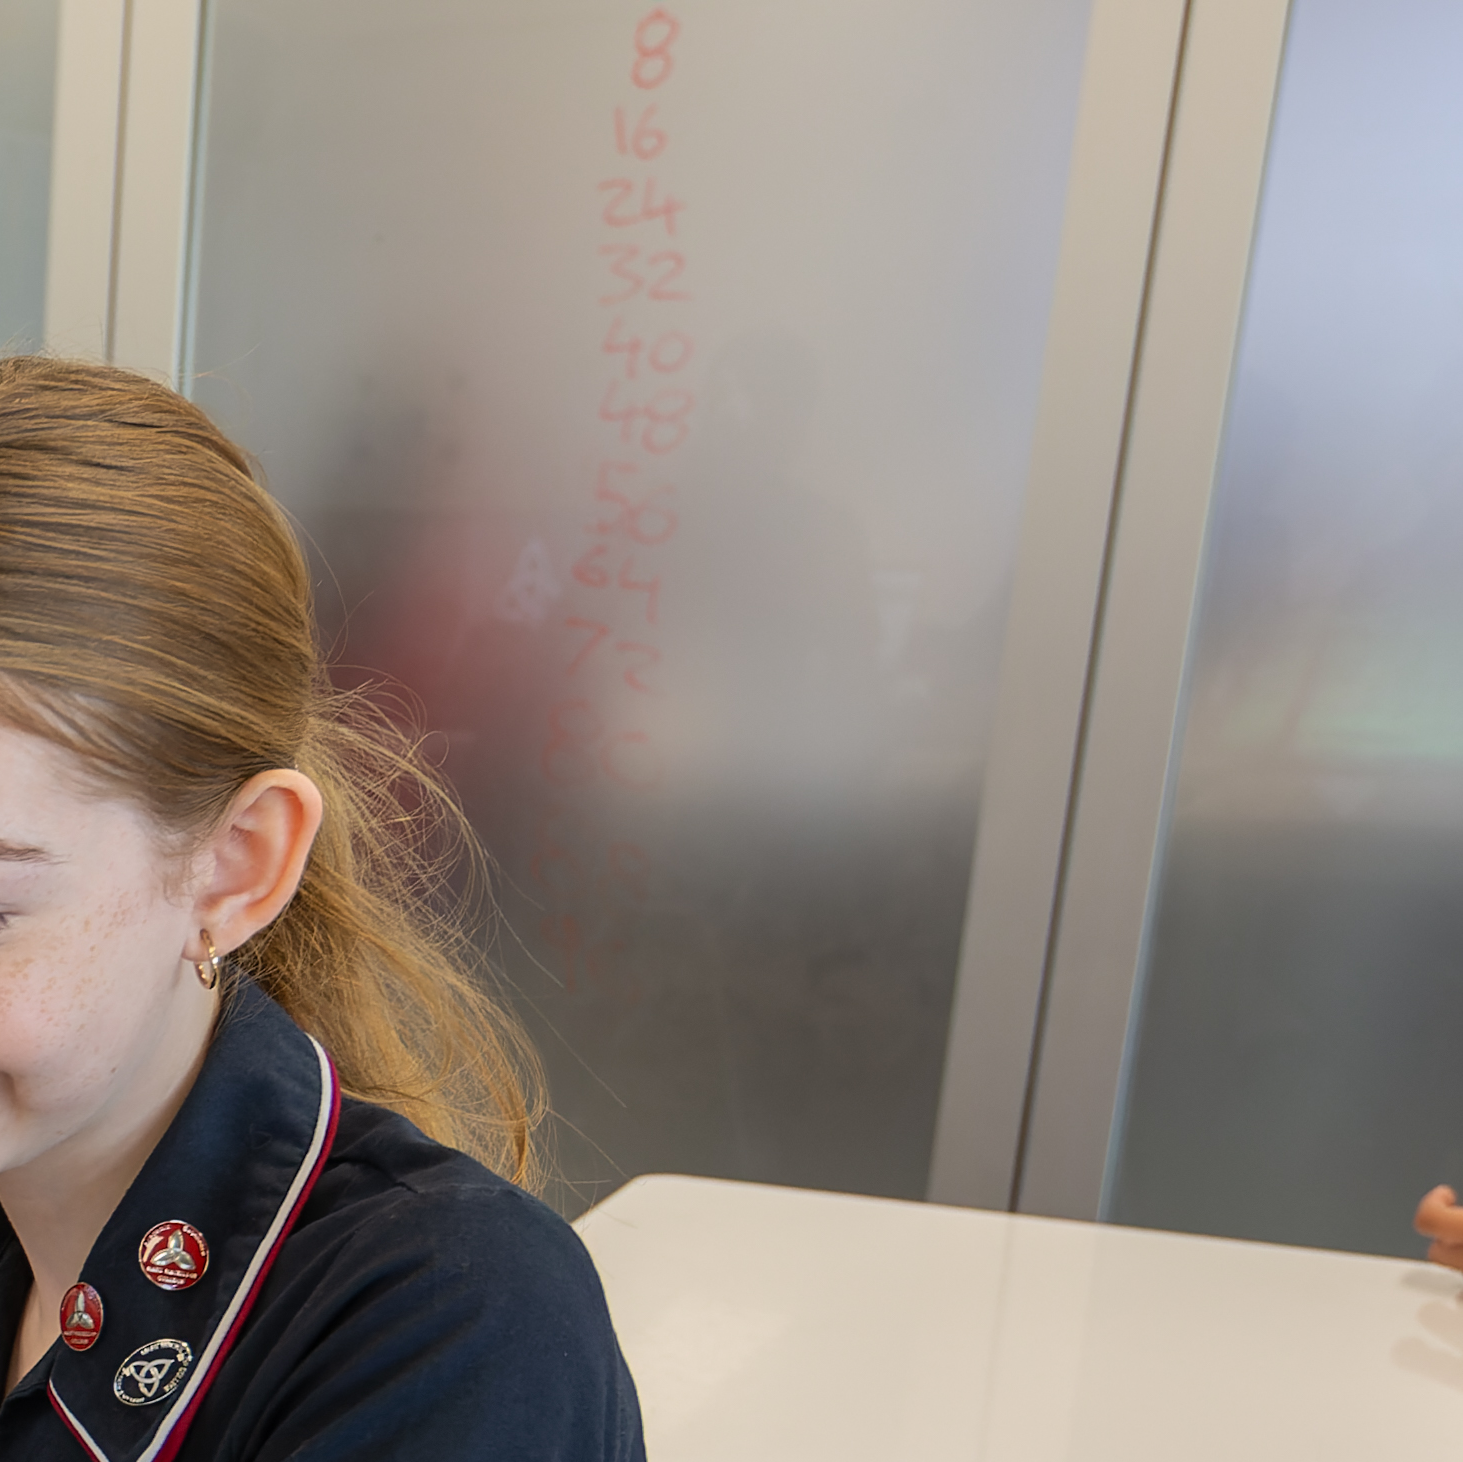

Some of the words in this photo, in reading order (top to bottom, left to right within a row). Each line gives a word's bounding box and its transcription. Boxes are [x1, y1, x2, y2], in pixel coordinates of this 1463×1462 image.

[631, 7, 679, 90] 8
[613, 104, 668, 161] 16
[596, 176, 686, 237] 24
[597, 244, 691, 307] 32
[602, 316, 694, 380] 40
[598, 378, 696, 455] 48
[573, 544, 661, 623] 64
